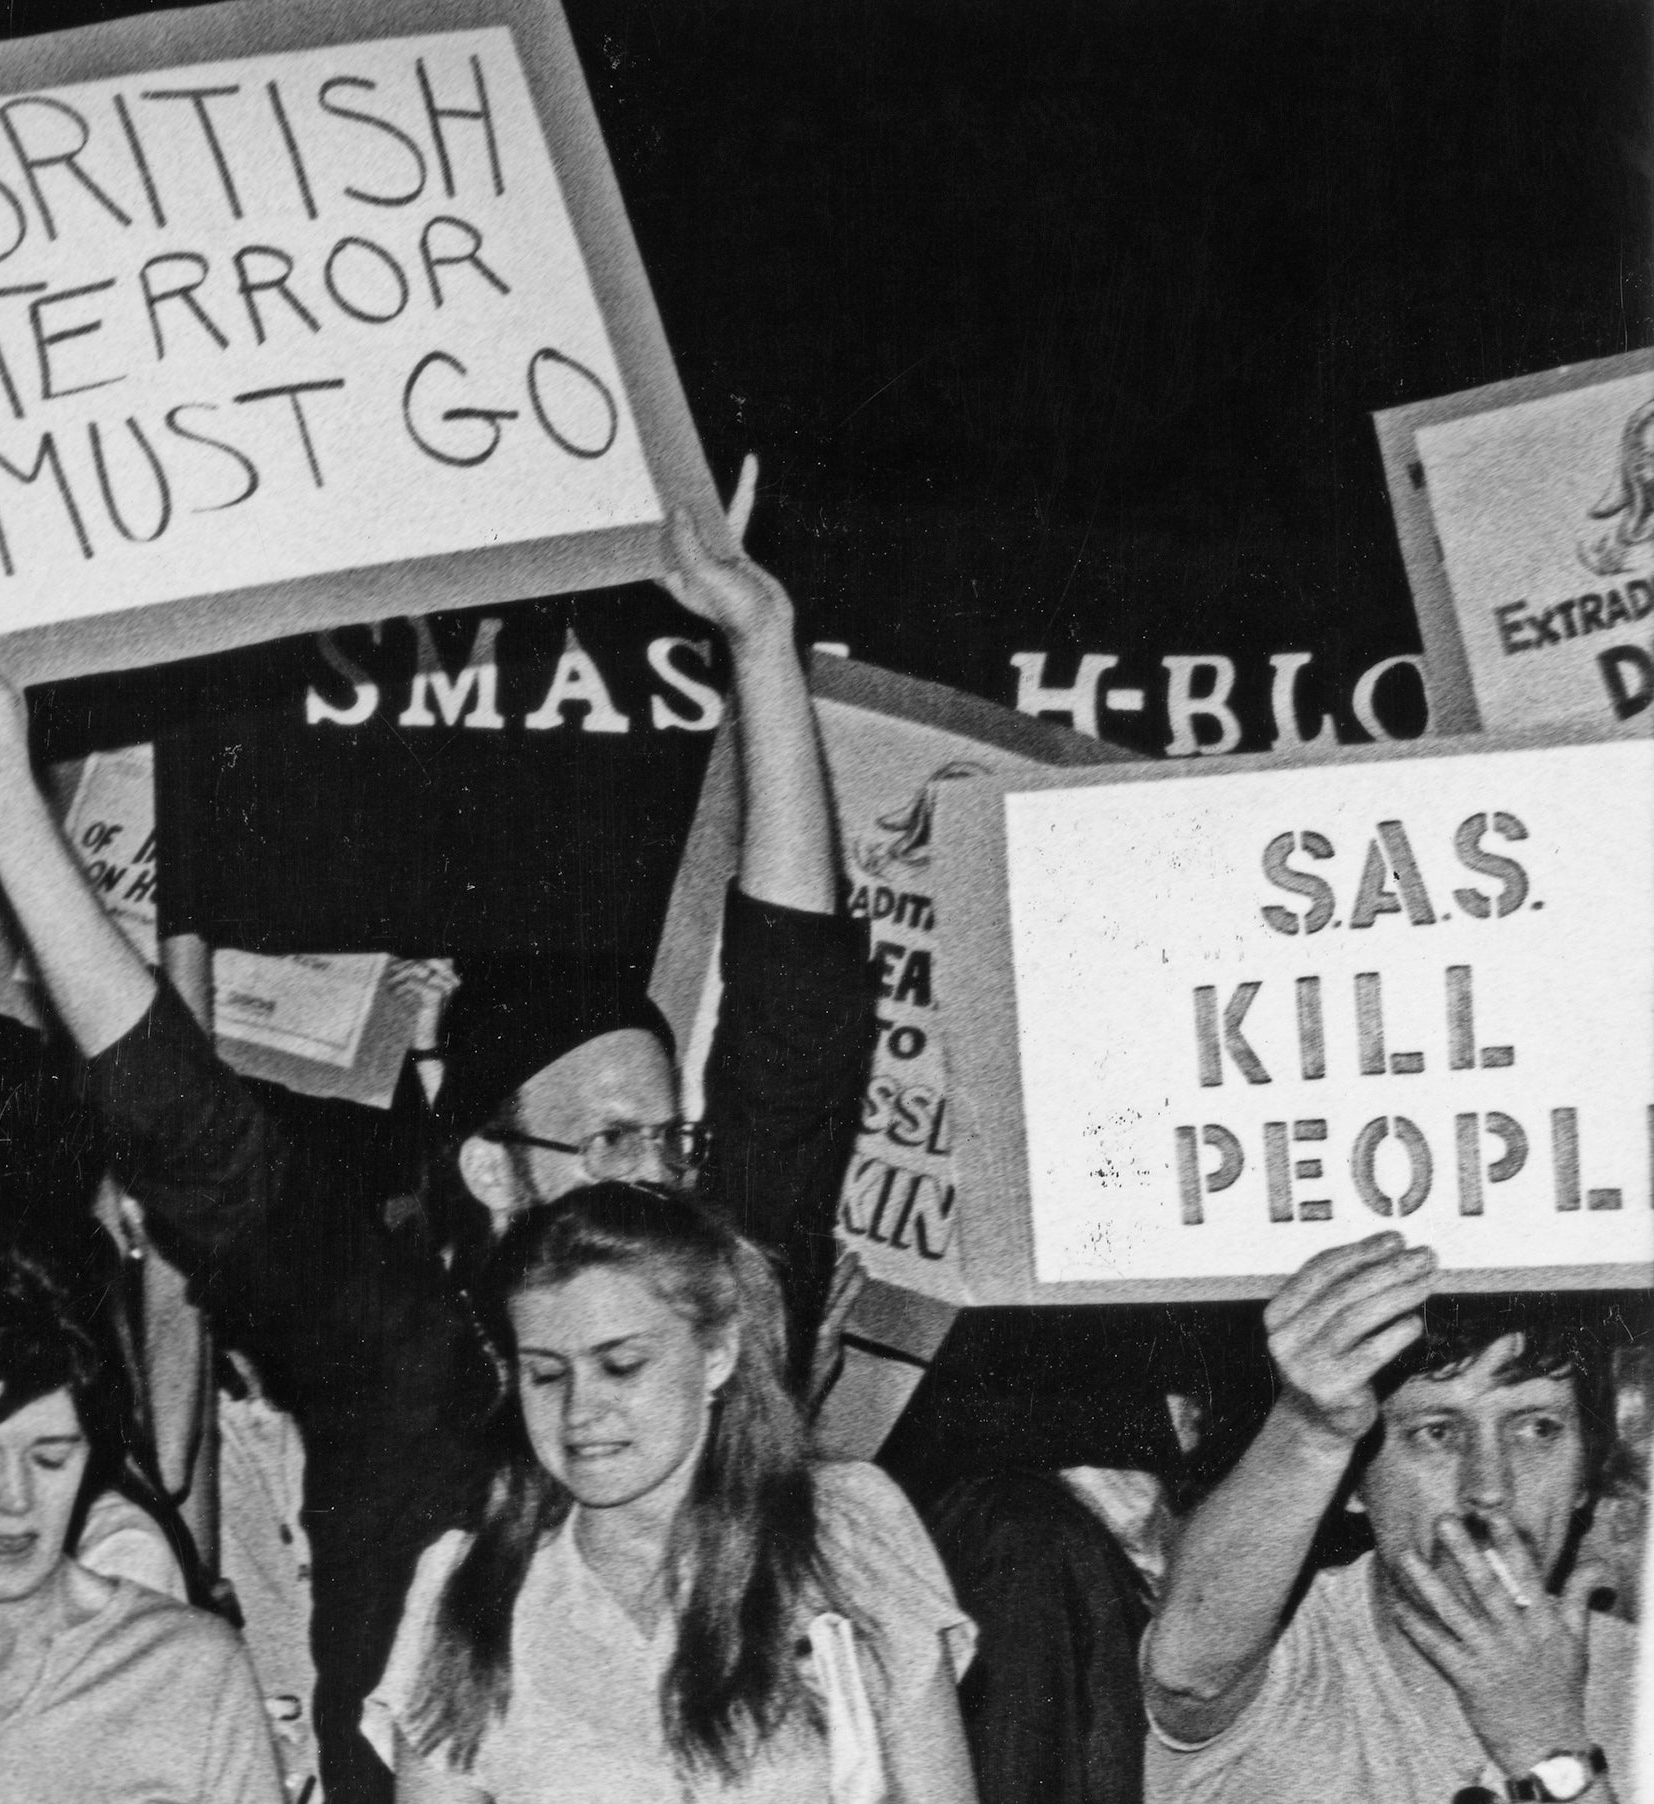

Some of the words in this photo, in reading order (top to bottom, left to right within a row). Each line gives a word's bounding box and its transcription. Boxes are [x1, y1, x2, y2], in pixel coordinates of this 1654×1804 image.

[403, 347, 618, 467] GO
[304, 617, 849, 733] SMAS
[81, 821, 124, 855] OF
[1192, 963, 1516, 1088] KILL
[1173, 1102, 1654, 1226] PEOPL
